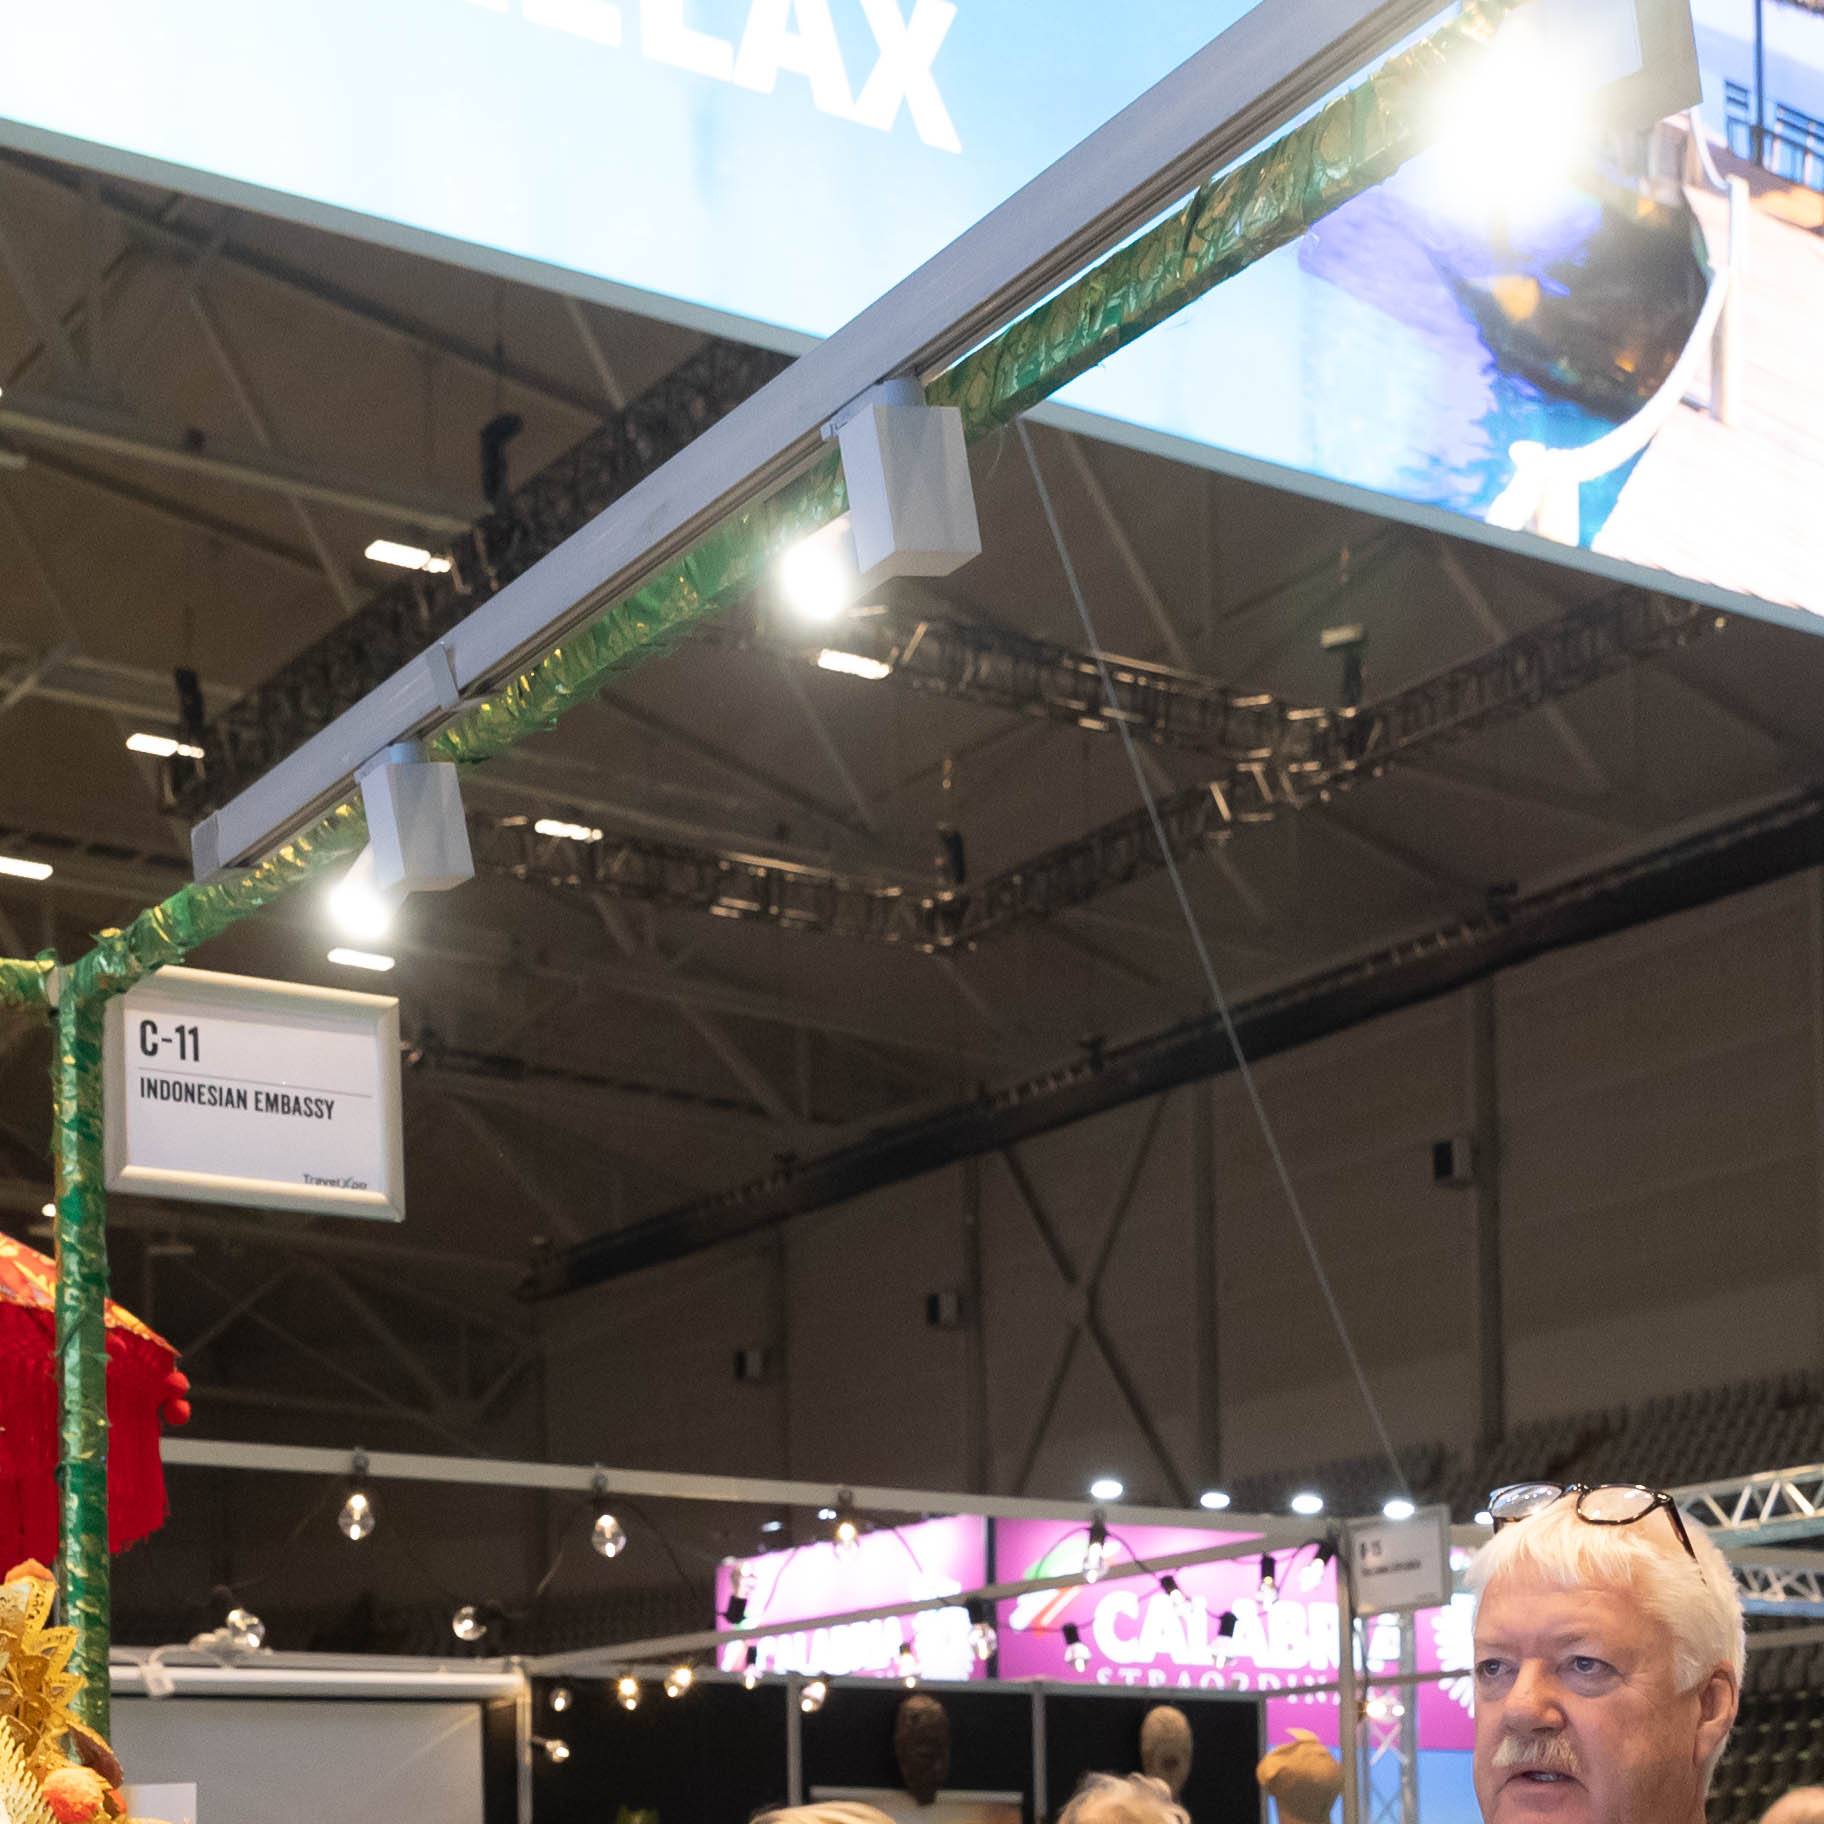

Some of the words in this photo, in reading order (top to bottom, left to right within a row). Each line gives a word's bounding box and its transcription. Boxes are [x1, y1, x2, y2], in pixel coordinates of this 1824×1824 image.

[139, 1019, 200, 1062] C-11
[140, 1077, 248, 1110] INDONESIAN
[254, 1091, 335, 1120] EMBASSY
